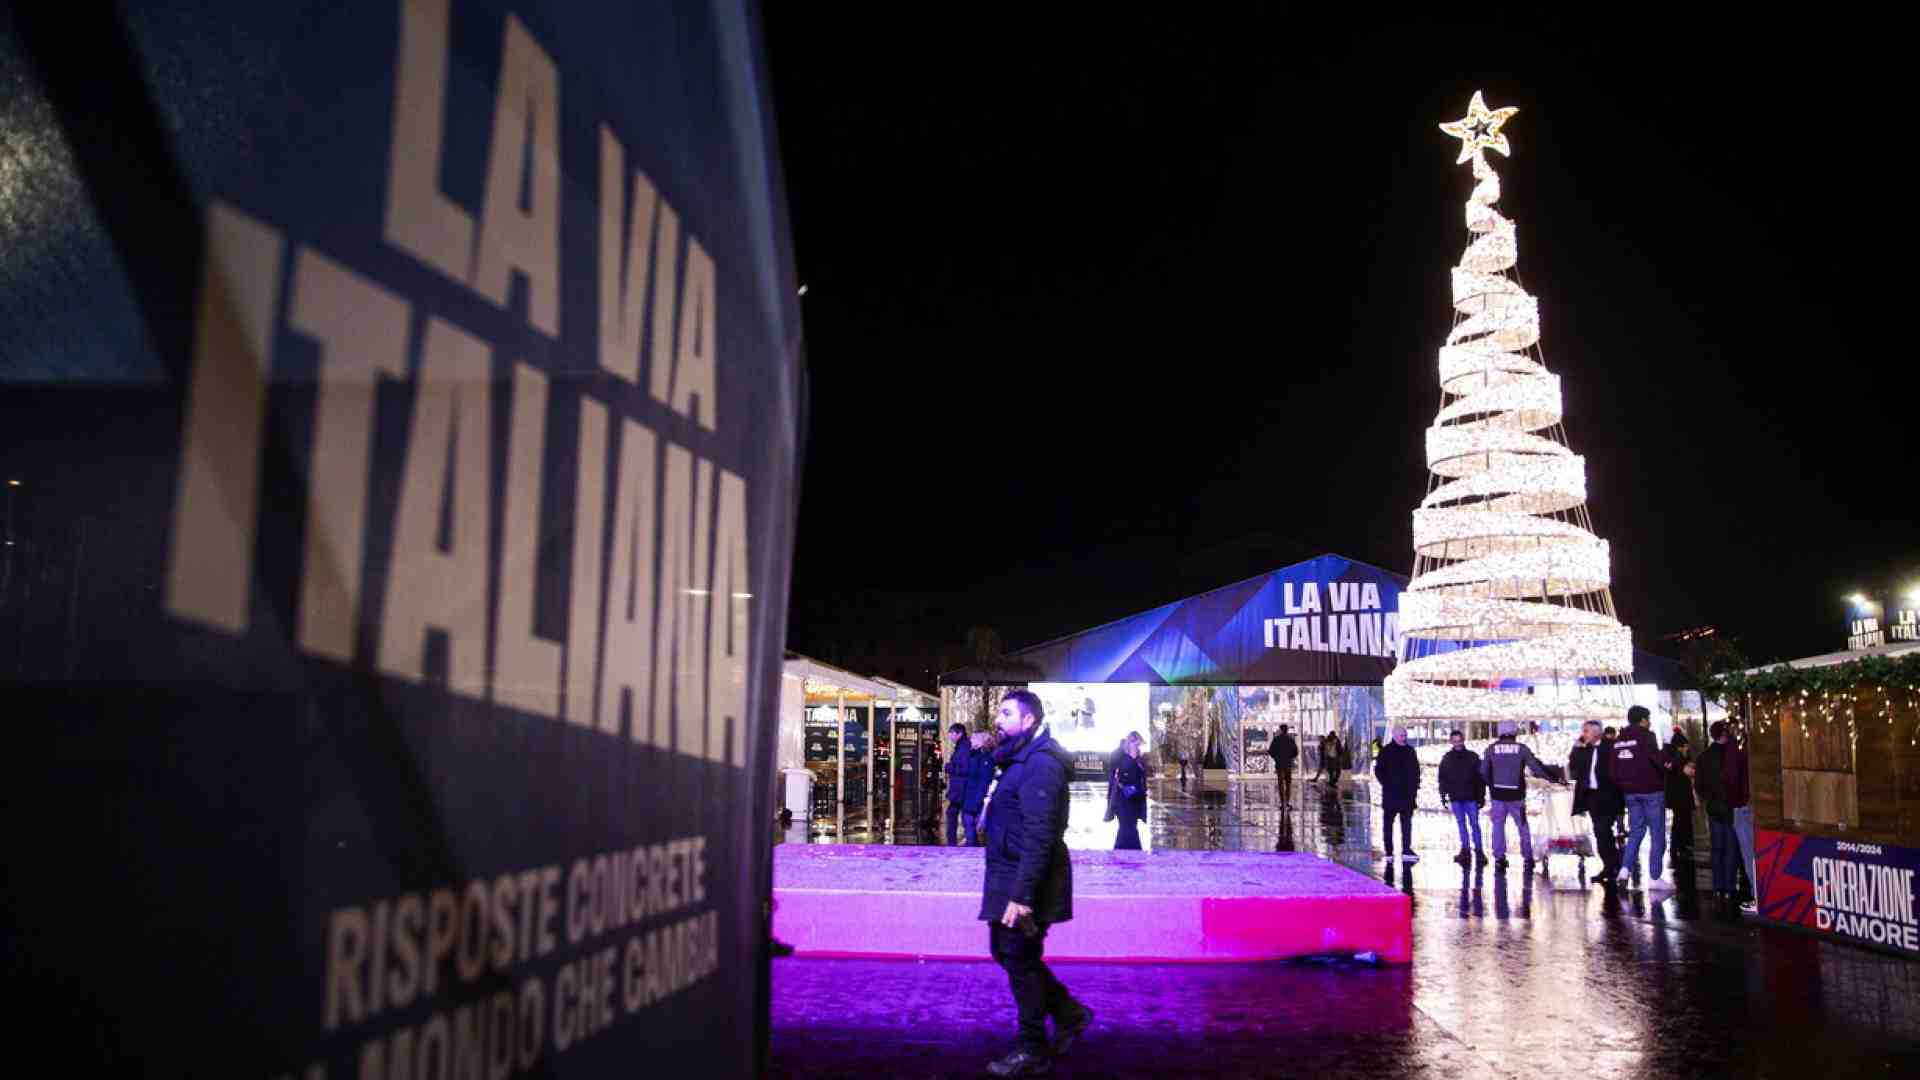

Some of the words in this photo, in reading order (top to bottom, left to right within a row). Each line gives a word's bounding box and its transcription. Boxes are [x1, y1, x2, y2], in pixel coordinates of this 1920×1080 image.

[384, 0, 561, 339] LA
[597, 124, 717, 434] VIA
[163, 198, 749, 768] ITALIANA
[1283, 581, 1321, 615] LA
[1328, 581, 1382, 611] VIA
[1263, 611, 1399, 658] ITALIANA
[1835, 841, 1882, 855] 2014/2024
[1812, 856, 1918, 926] GENERAZIONE
[322, 864, 564, 1031] RISPOSTE
[566, 835, 708, 945] CONCRETE
[1815, 908, 1920, 951] D'AMORE
[552, 946, 618, 1053] CHE
[622, 910, 719, 1015] CAMBIA
